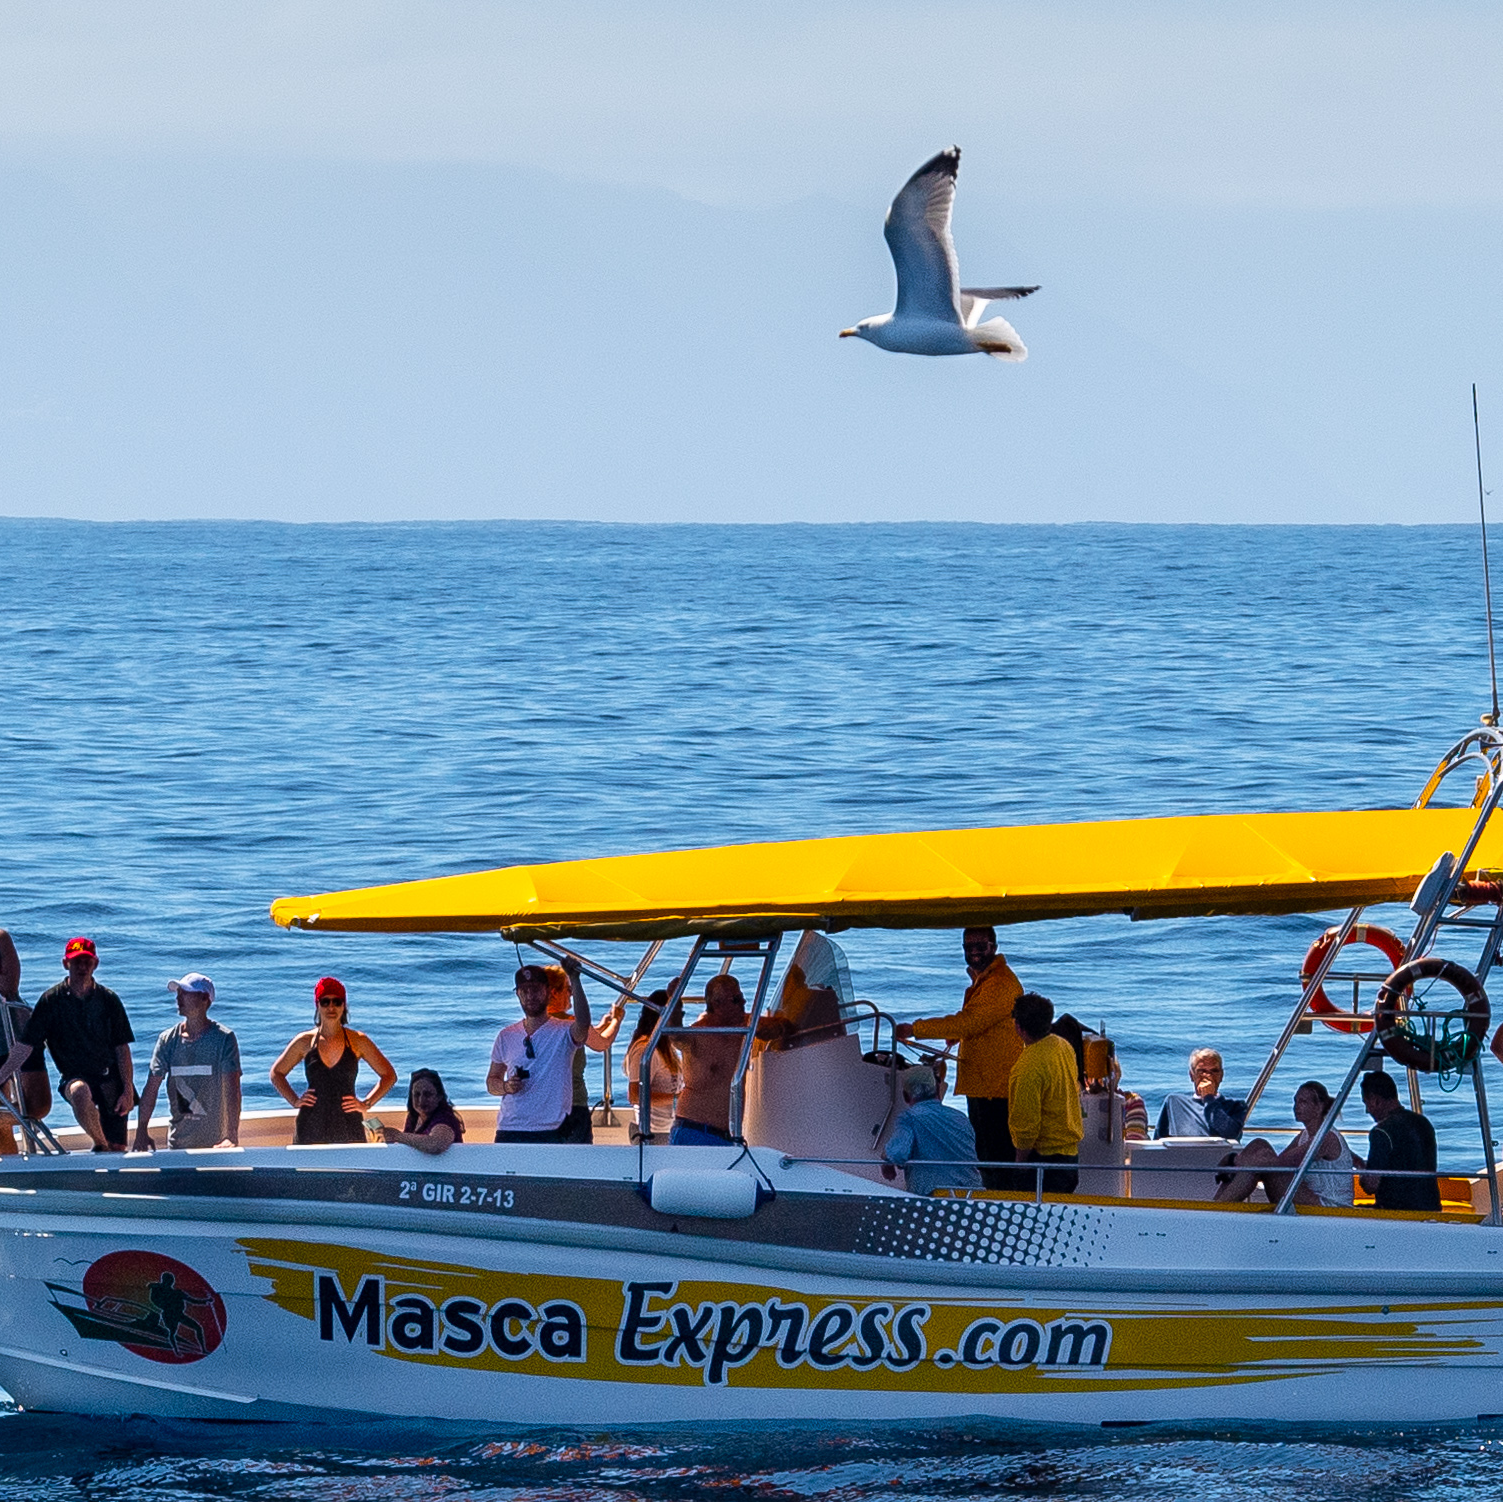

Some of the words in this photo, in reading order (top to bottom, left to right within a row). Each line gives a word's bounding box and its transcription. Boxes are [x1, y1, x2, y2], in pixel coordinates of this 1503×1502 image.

[422, 1183, 455, 1203] GIR
[459, 1186, 515, 1208] 2-7-13
[315, 1272, 585, 1361] Masca
